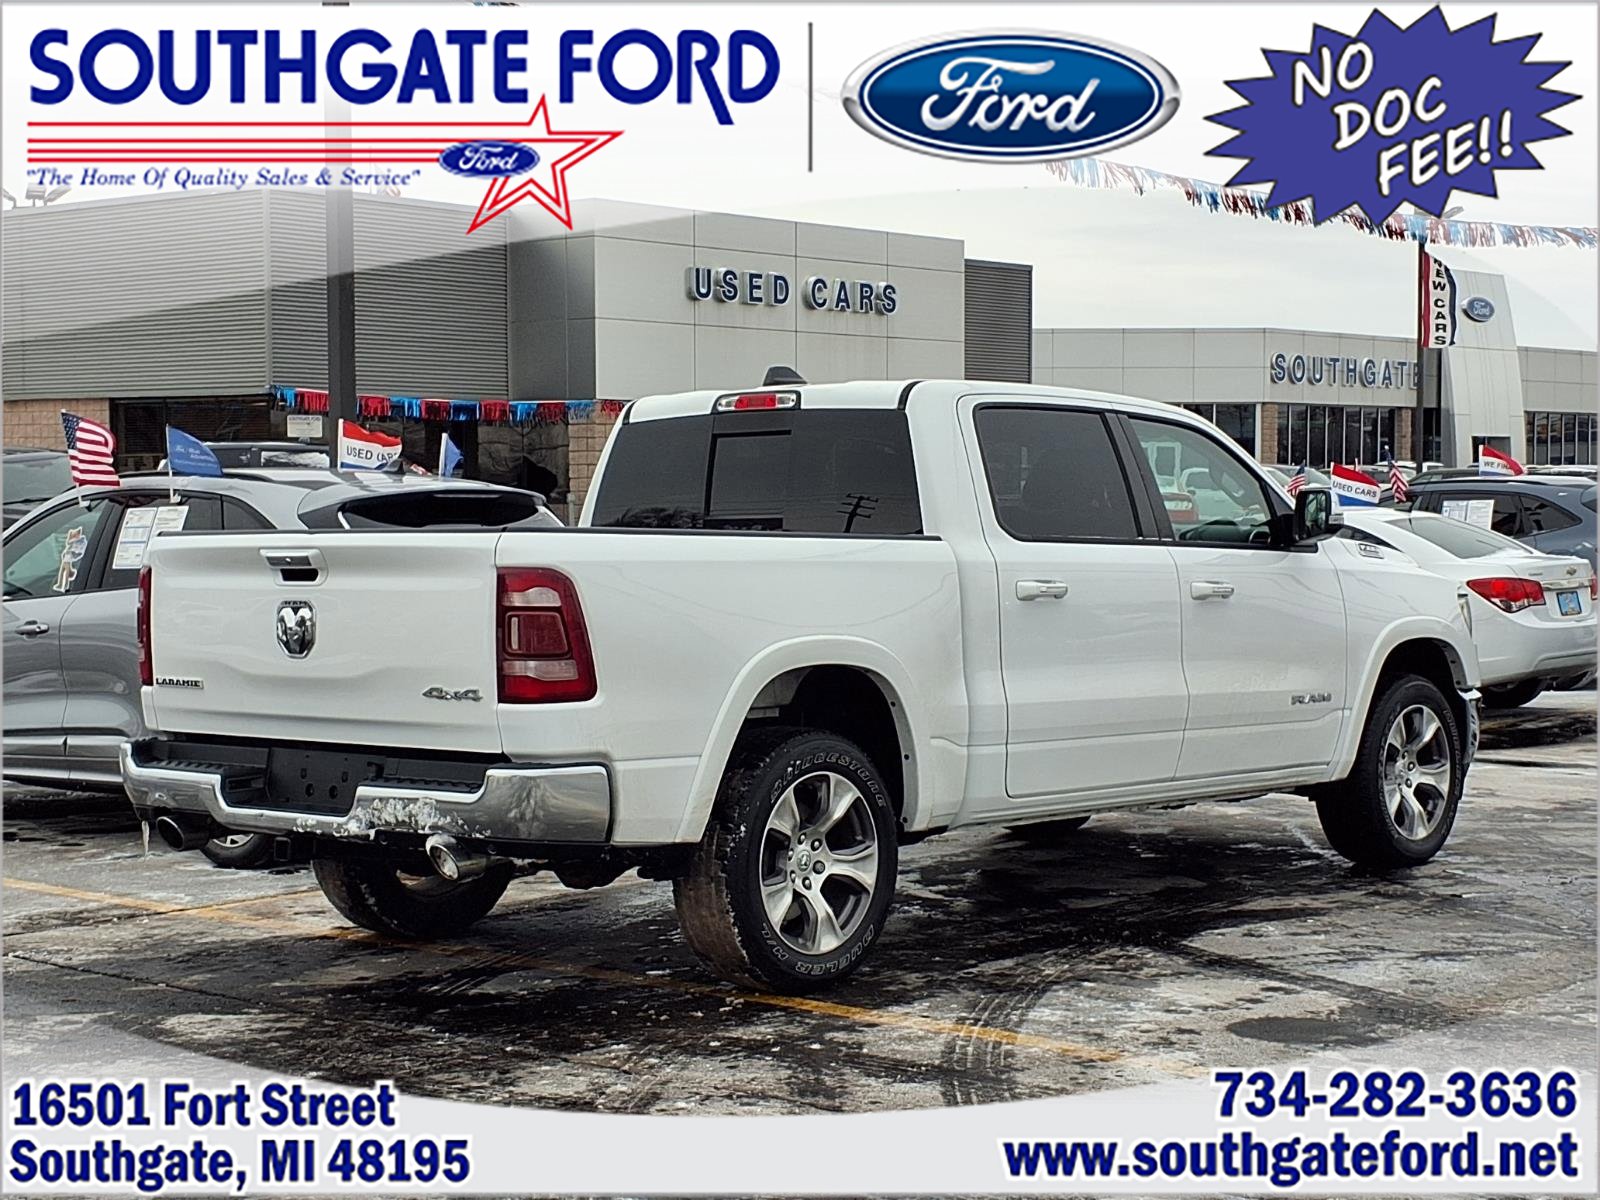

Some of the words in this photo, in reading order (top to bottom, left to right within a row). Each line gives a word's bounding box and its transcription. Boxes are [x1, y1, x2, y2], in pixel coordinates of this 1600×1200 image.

[688, 266, 790, 306] USED
[803, 276, 897, 315] CARS
[1433, 298, 1447, 346] CARS
[346, 445, 373, 461] USED
[1332, 480, 1353, 493] USED
[1354, 487, 1378, 498] CARS
